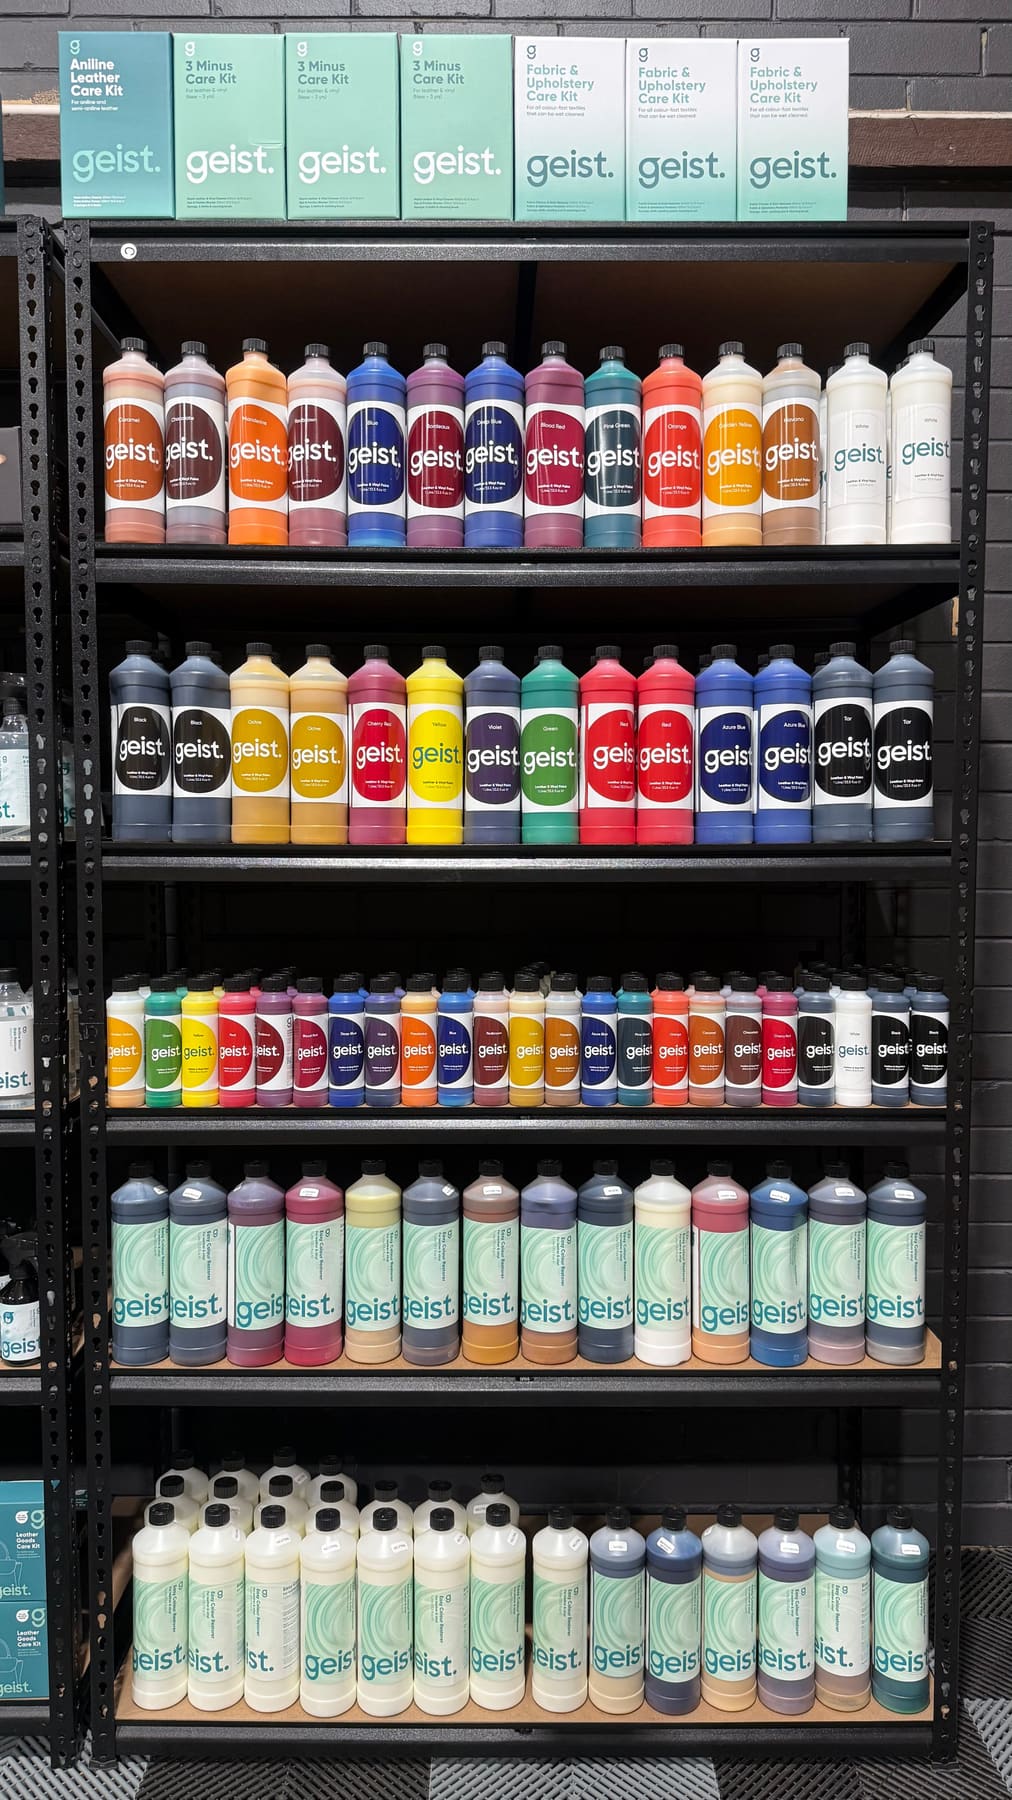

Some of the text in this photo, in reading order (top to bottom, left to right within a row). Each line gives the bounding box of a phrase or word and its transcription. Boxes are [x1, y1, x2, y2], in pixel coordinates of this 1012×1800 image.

[70, 40, 80, 55] g
[185, 42, 195, 56] g
[297, 42, 308, 56] g
[413, 42, 423, 56] g
[527, 45, 536, 59] g
[639, 48, 648, 62] g
[750, 48, 760, 62] g
[70, 59, 114, 70] Aniline
[186, 61, 232, 71] 3 Minus
[298, 61, 345, 71] 3 Minus
[414, 61, 461, 71] 3 Minus
[527, 65, 578, 76] Fabric &
[71, 72, 120, 83] Leather
[186, 74, 236, 84] Care Kit
[298, 74, 349, 84] Care Kit
[414, 74, 464, 84] Care Kit
[639, 67, 690, 78] Fabric &
[750, 67, 802, 77] Fabric &
[71, 85, 123, 96] Care Kit
[527, 78, 594, 91] Upholstery
[639, 80, 706, 93] Upholstery
[750, 79, 817, 92] Upholstery
[527, 91, 578, 102] Care Kit
[639, 93, 689, 104] Care Kit
[750, 92, 801, 103] Care Kit
[73, 144, 160, 183] geist.
[187, 144, 274, 183] geist.
[299, 145, 386, 184] geist.
[414, 145, 501, 184] geist.
[527, 150, 614, 187] geist.
[639, 151, 725, 189] geist.
[750, 151, 836, 189] geist.
[106, 438, 159, 469] geist.
[231, 440, 284, 468] geist.
[348, 442, 400, 475] geist.
[466, 440, 517, 473] geist.
[765, 437, 819, 471] geist.
[834, 444, 884, 471] geist.
[120, 736, 165, 761] geist.
[176, 739, 224, 764] geist.
[233, 739, 281, 763] geist.
[356, 742, 403, 769] geist.
[818, 736, 871, 766] geist.
[877, 740, 932, 770] geist.
[292, 745, 341, 769] geist.
[413, 743, 461, 769] geist.
[524, 747, 577, 775] geist.
[640, 743, 691, 771] geist.
[184, 1046, 214, 1059] geist.
[404, 1044, 433, 1058] geist.
[440, 1043, 468, 1057] geist.
[585, 1044, 614, 1058] geist.
[594, 1643, 643, 1671] geis
